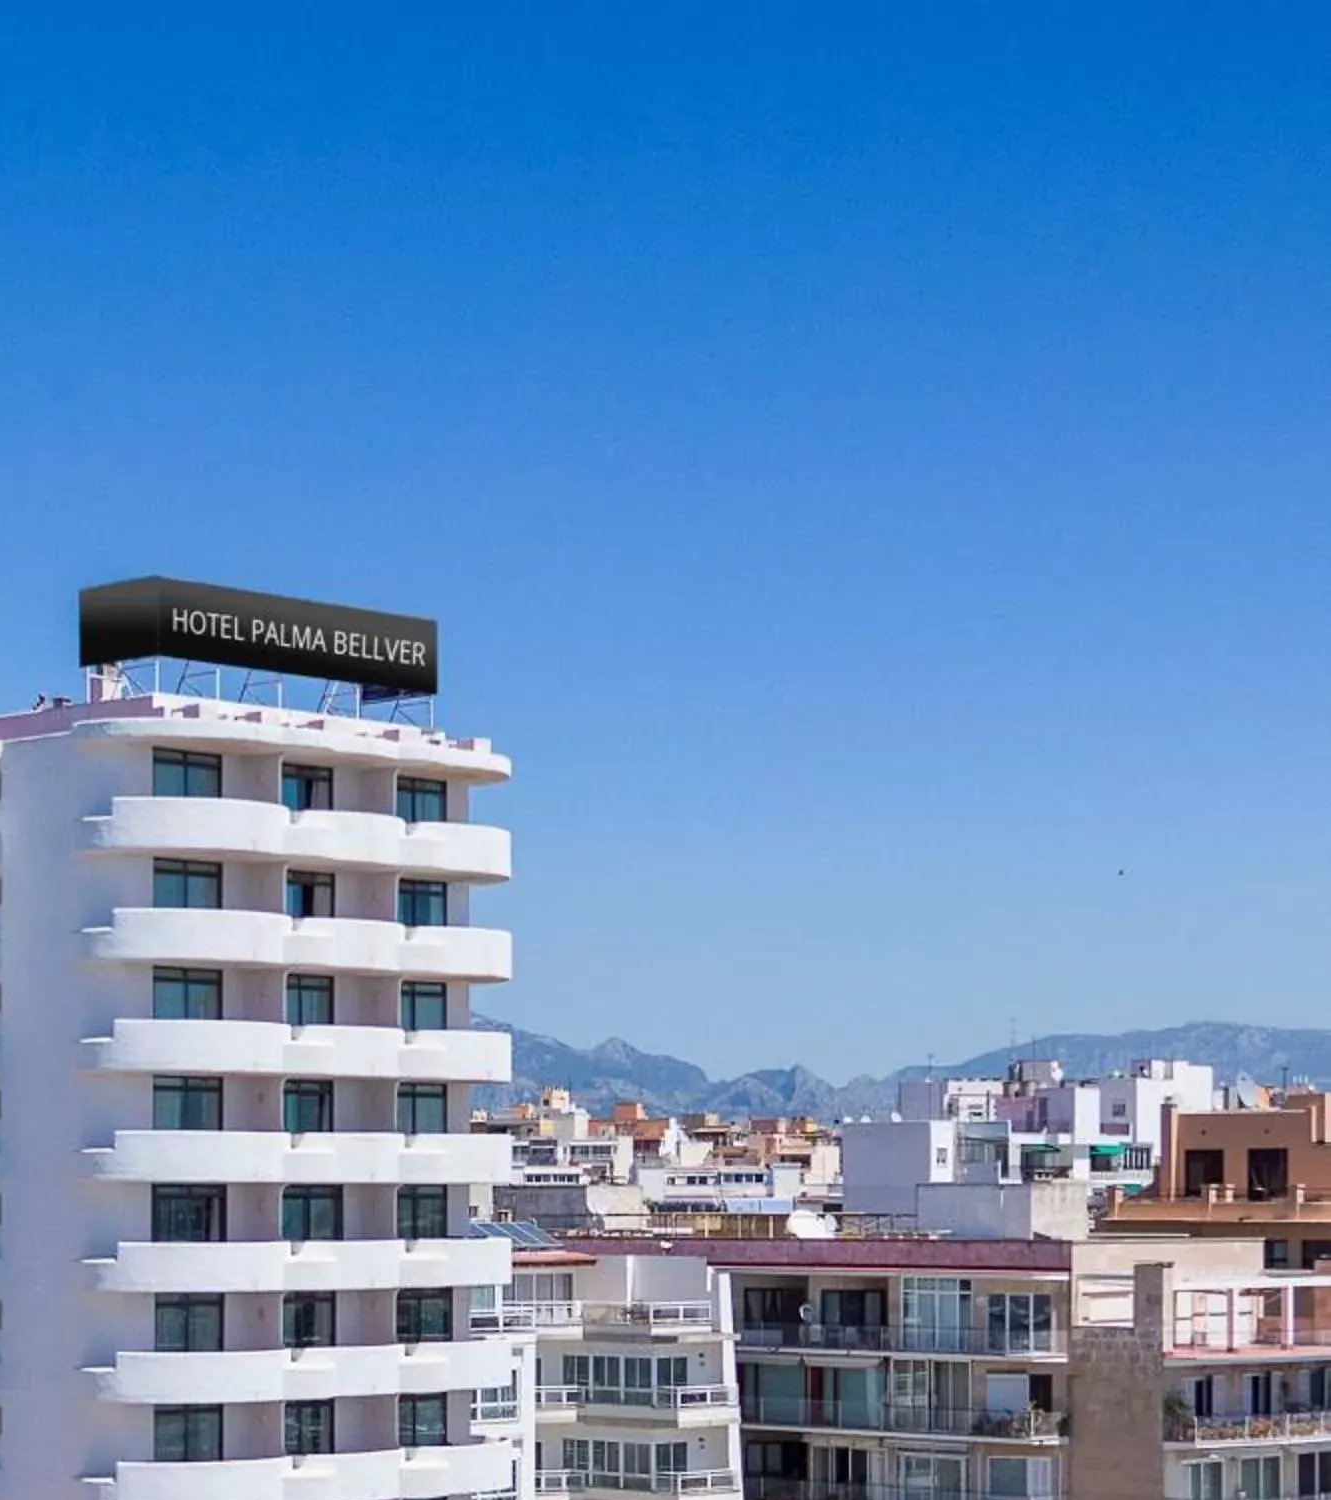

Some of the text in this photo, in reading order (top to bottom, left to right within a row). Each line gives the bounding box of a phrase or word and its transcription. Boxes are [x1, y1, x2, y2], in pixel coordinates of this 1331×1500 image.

[172, 608, 426, 667] HOTEL PALMA BELLVER
